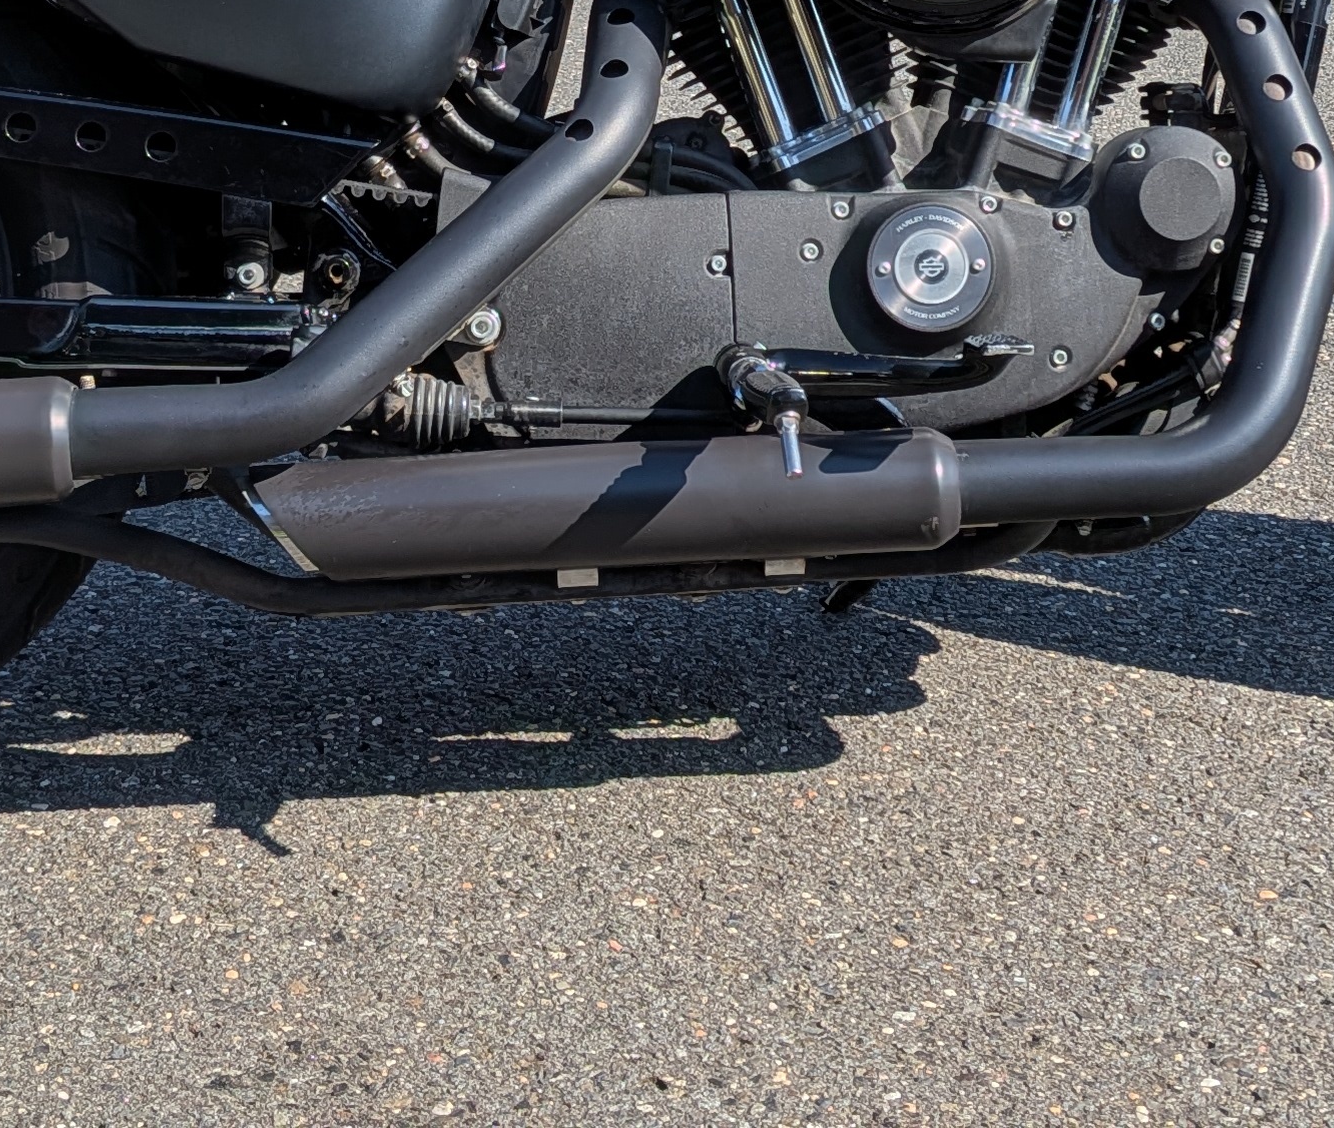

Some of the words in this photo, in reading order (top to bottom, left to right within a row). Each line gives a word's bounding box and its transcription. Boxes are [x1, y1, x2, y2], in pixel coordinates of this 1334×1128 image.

[895, 214, 924, 233] HARLEY
[903, 306, 928, 319] MOTOR
[929, 305, 961, 319] COMPANY
